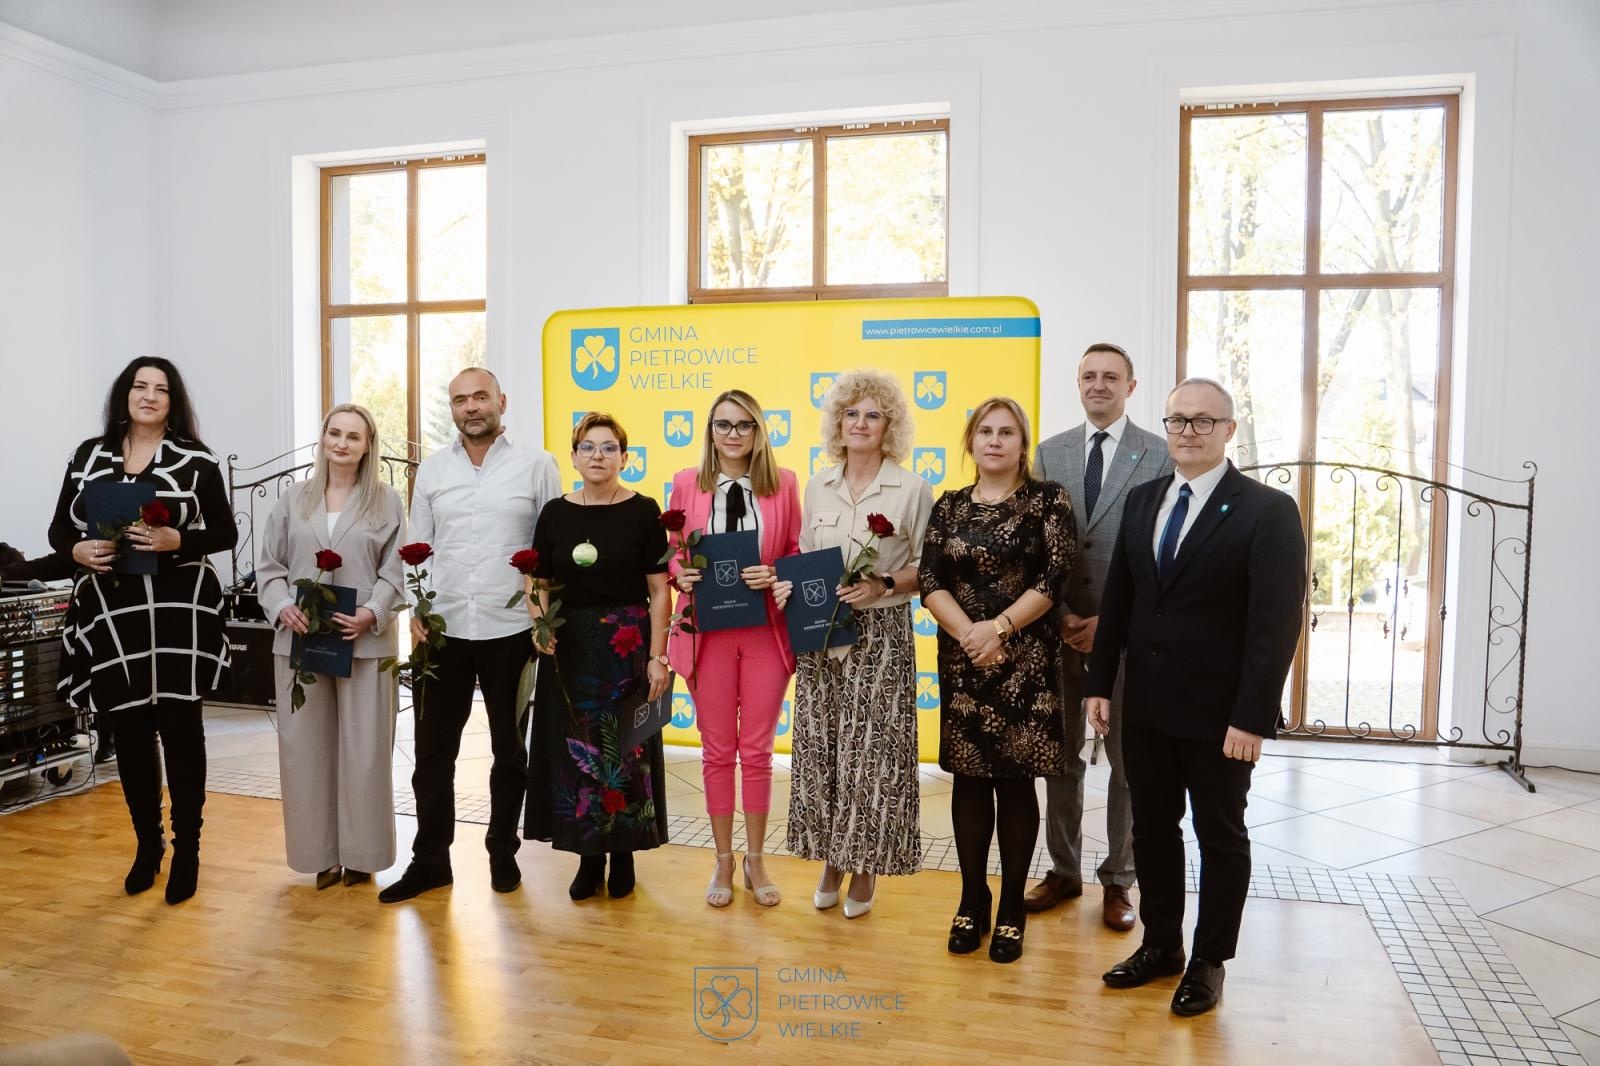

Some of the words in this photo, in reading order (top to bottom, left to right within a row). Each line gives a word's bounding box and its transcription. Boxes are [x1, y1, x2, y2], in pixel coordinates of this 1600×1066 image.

[629, 325, 698, 342] GMINA
[864, 325, 1003, 336] www.pietrowicewielkie.com.pl
[630, 347, 760, 366] PIETROWICE
[629, 372, 713, 390] WIELKIE
